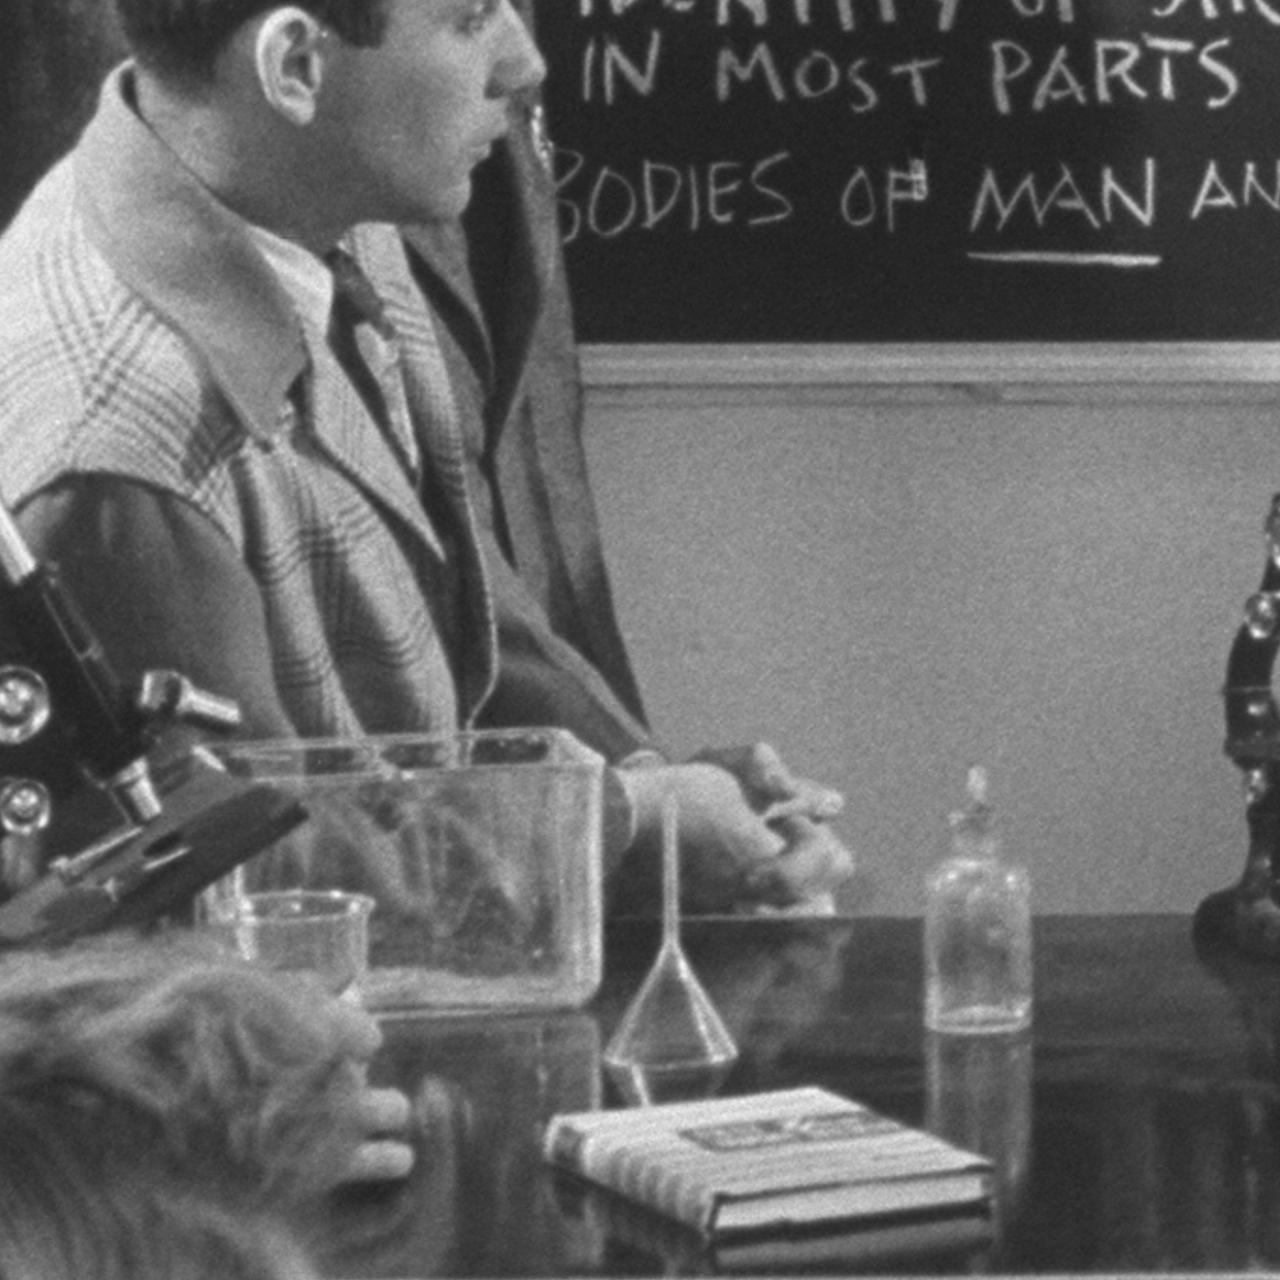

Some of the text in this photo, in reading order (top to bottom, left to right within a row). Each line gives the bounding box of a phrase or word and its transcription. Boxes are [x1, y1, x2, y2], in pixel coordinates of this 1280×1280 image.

[583, 29, 661, 104] IN
[715, 41, 940, 113] MOST
[992, 32, 1239, 113] PARTS
[840, 158, 930, 230] OF
[971, 156, 1157, 229] MAN
